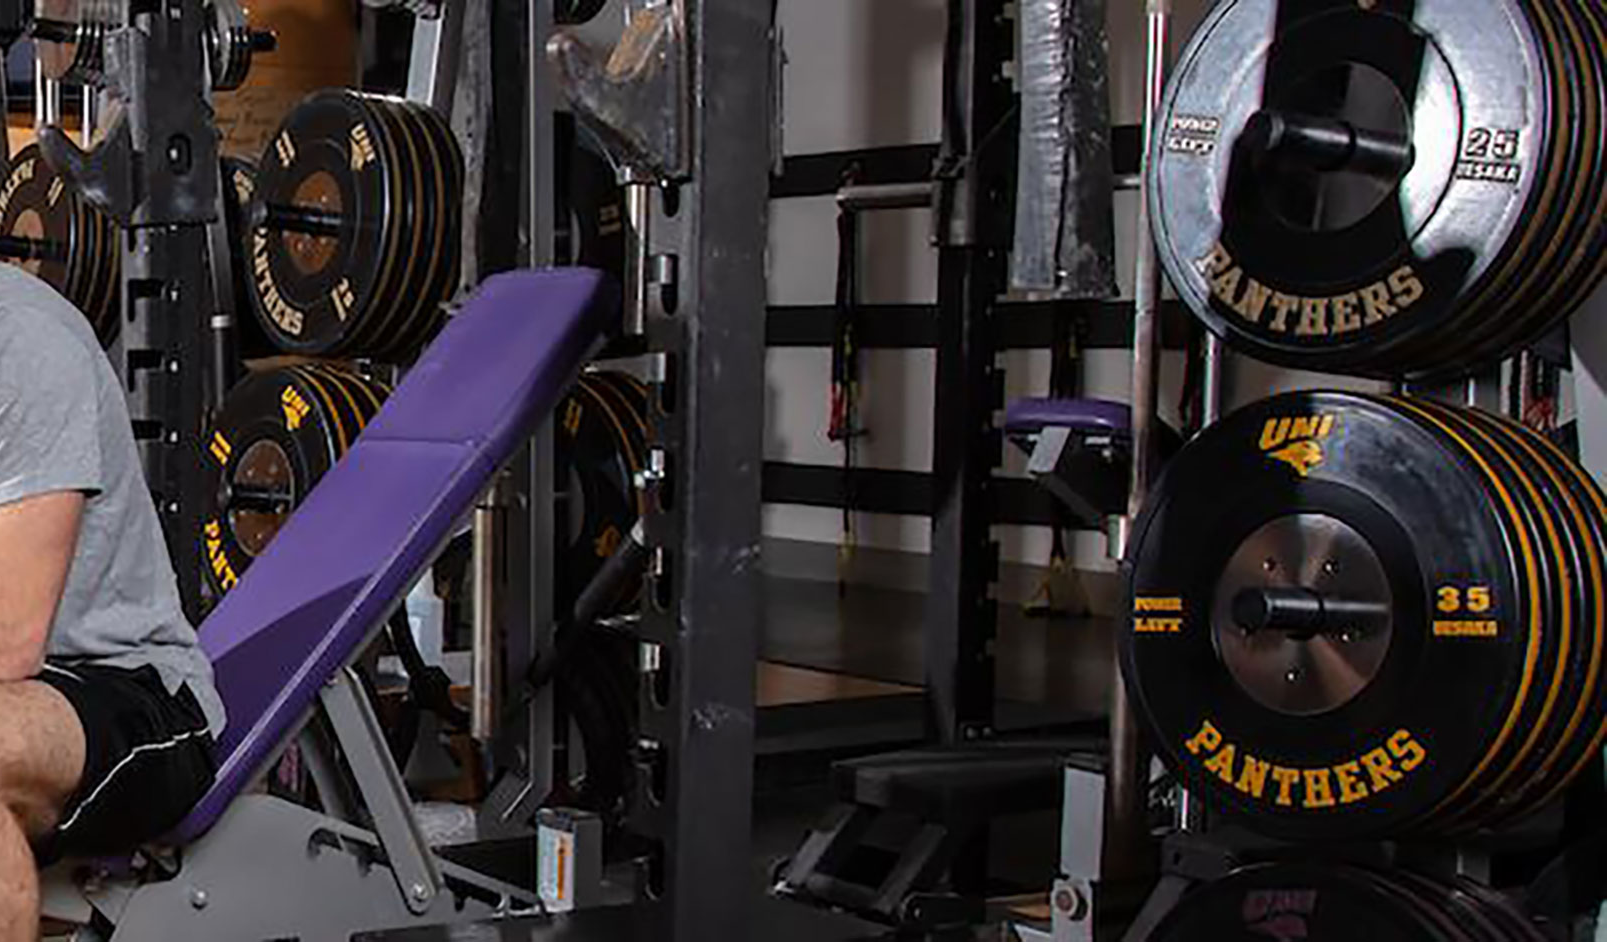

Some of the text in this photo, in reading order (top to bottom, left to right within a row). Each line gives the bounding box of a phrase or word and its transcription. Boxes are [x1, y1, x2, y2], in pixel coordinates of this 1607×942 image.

[351, 123, 375, 163] UNI
[1466, 127, 1519, 160] 25
[1195, 241, 1425, 336] PANTHERS
[1259, 413, 1334, 450] UNI
[1185, 719, 1426, 808] PANTHERS
